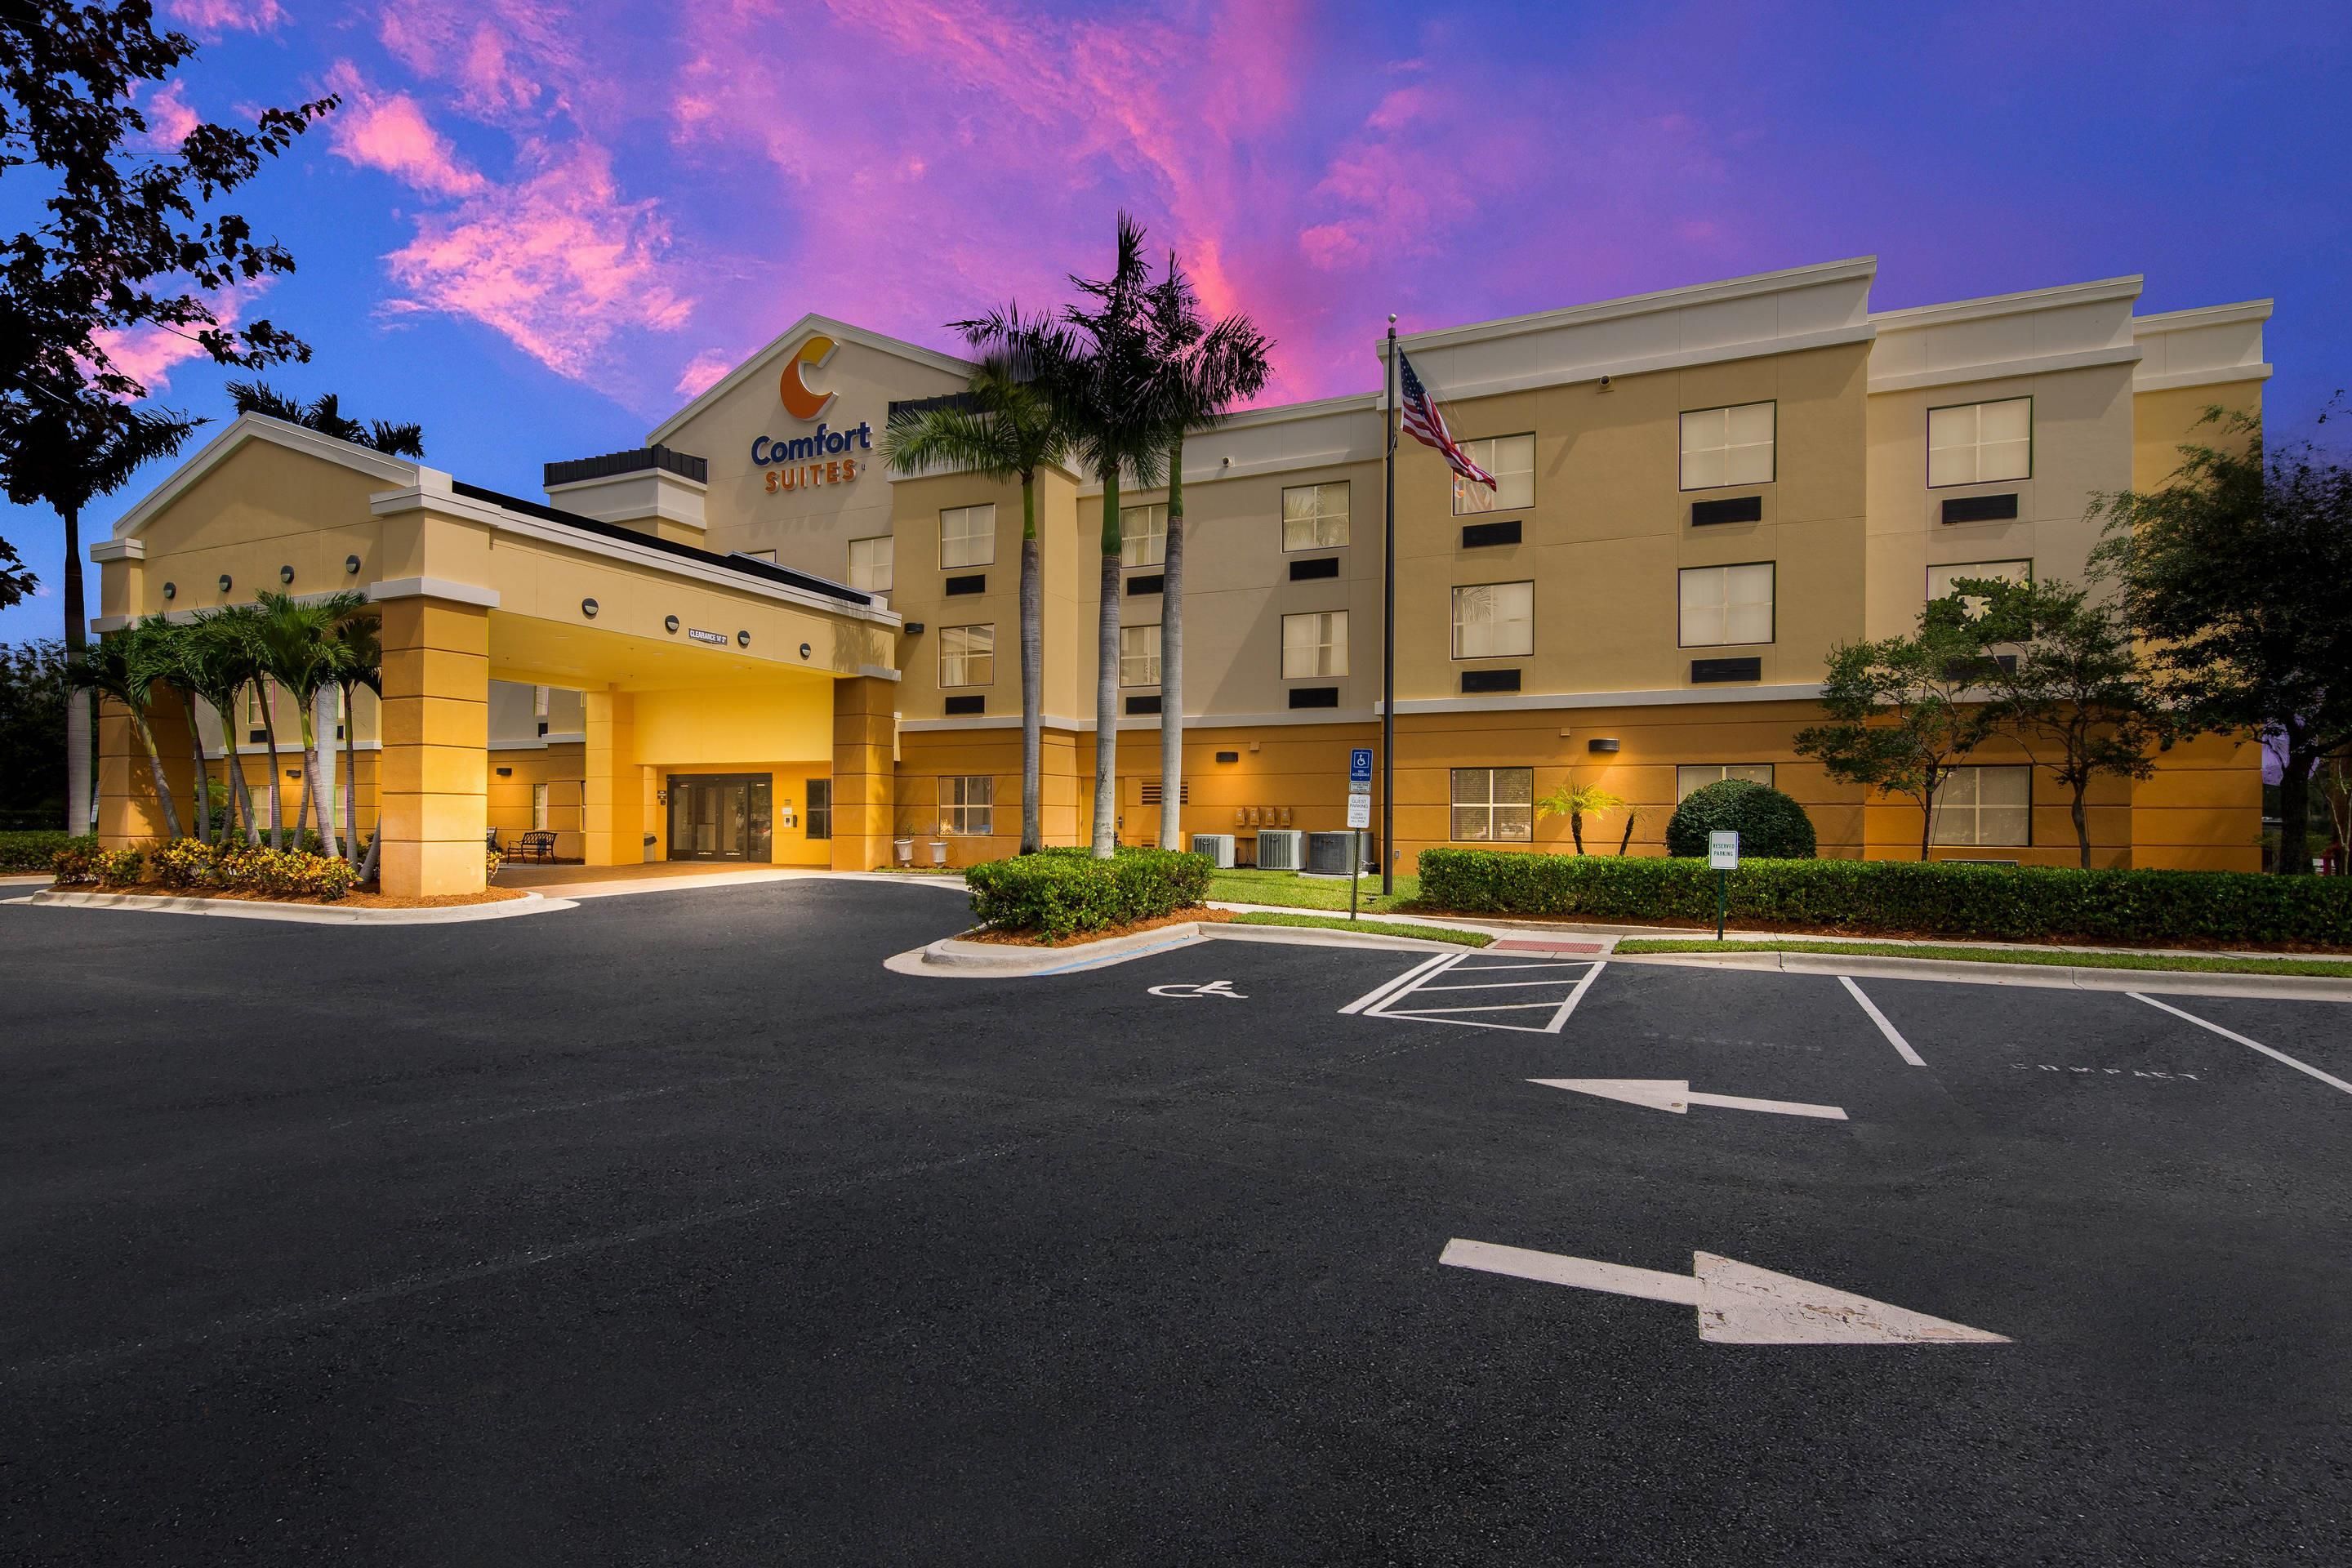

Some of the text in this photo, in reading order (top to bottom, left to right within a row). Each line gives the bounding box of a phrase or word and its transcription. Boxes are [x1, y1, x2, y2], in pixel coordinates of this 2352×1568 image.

[751, 421, 873, 467] Comfort
[765, 459, 858, 494] SUITES
[690, 630, 716, 641] CLEARANCE
[2009, 1063, 2200, 1081] COMPACT
